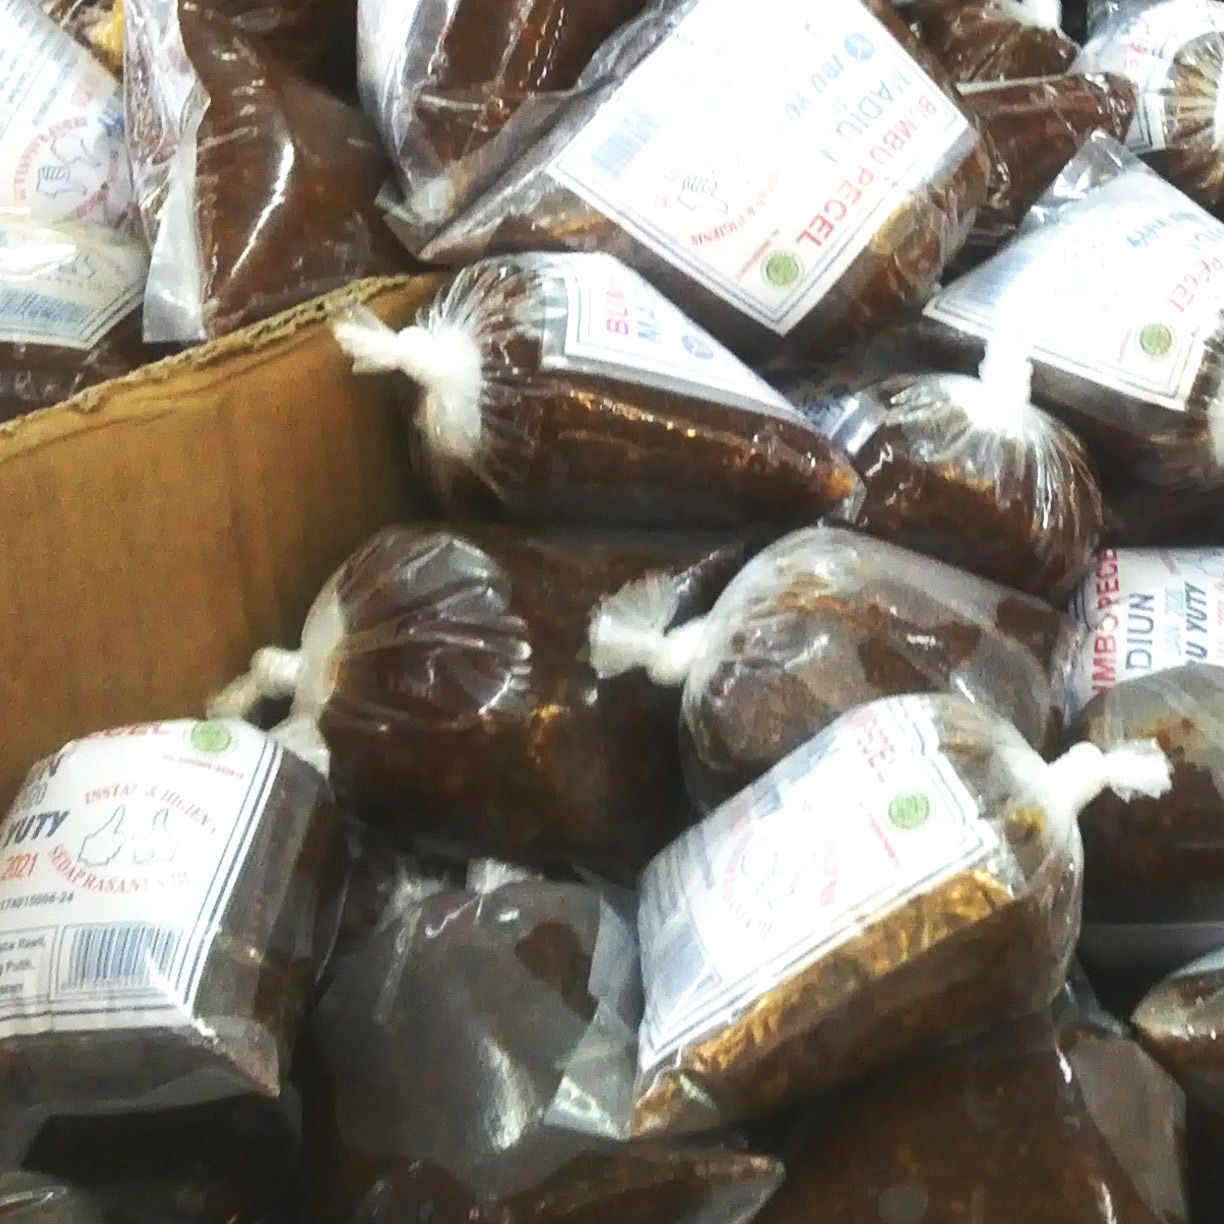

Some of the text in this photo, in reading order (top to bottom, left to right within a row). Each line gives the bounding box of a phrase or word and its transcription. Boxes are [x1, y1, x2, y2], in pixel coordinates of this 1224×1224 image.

[792, 163, 878, 255] PECEL
[1125, 592, 1155, 669] DIUN
[1184, 581, 1207, 633] YUTY
